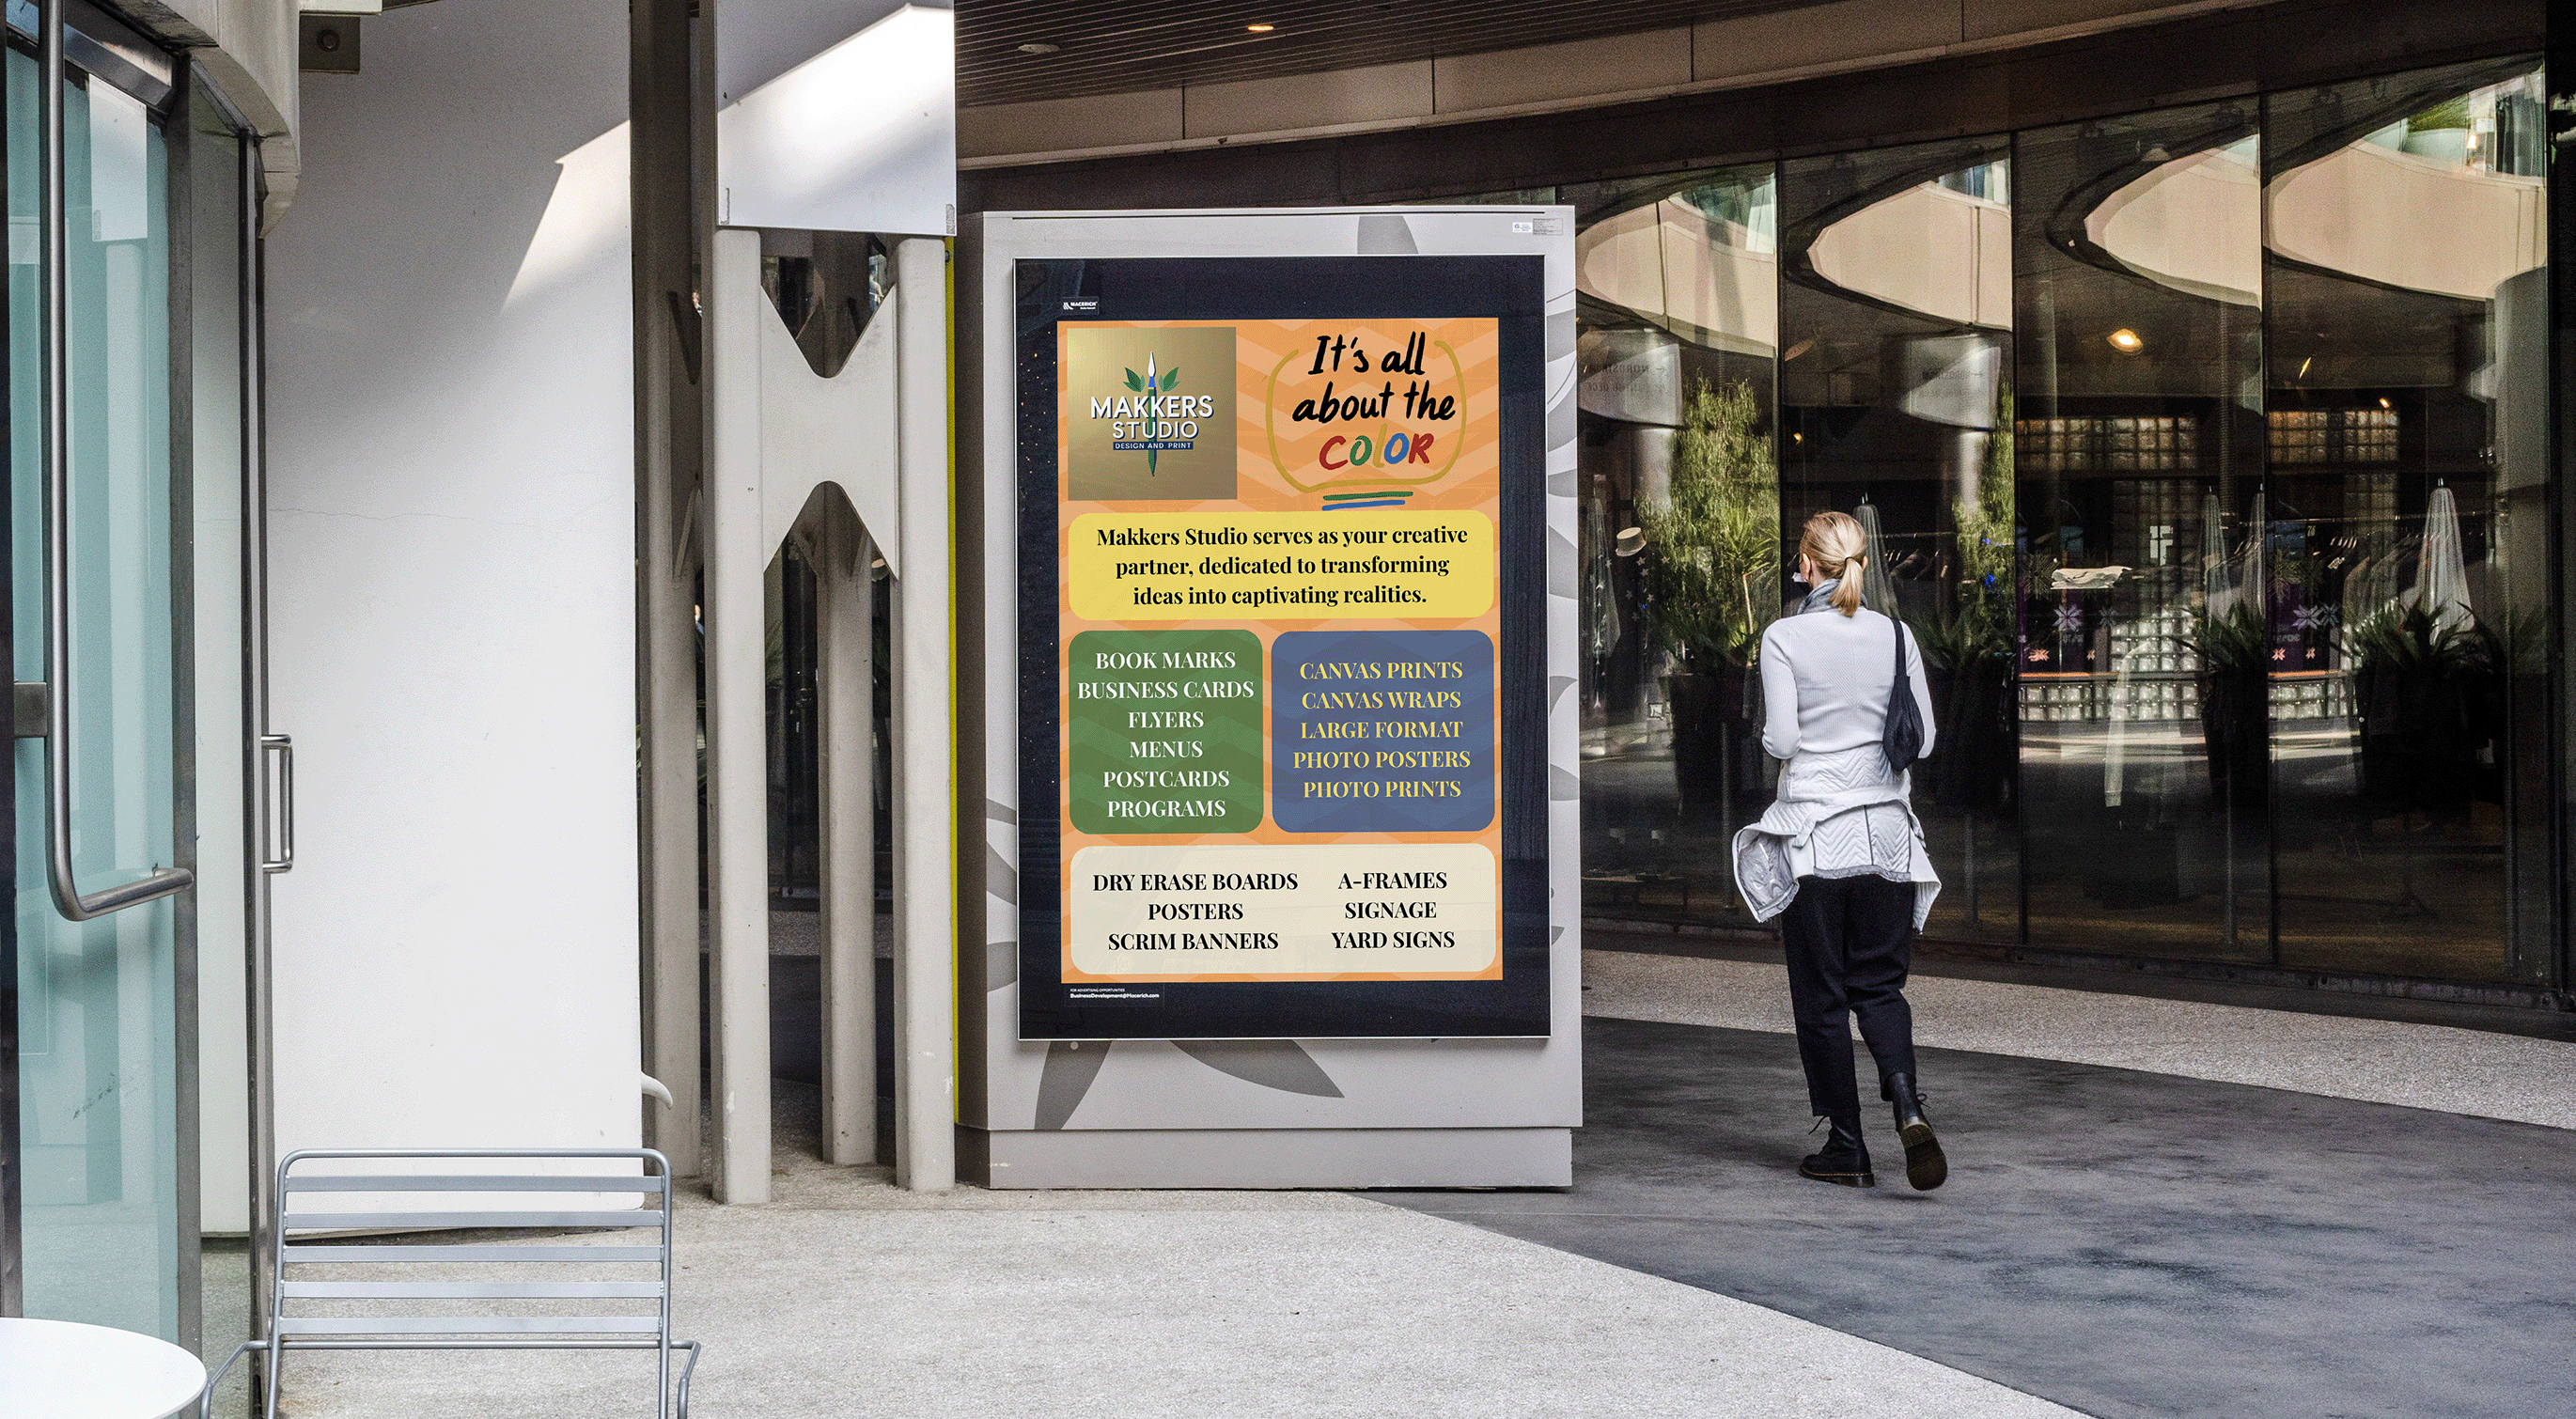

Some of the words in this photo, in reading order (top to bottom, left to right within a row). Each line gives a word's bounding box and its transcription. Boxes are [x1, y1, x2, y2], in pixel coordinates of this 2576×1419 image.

[1307, 334, 1369, 375] It's
[1381, 331, 1426, 376] all
[1090, 395, 1214, 419] MAKKERS
[1291, 381, 1395, 424] about
[1403, 380, 1456, 421] the
[1113, 420, 1199, 440] STUDIO
[1115, 442, 1145, 450] DESIGN
[1097, 527, 1180, 546] Makkers
[1185, 526, 1248, 546] Studio
[1253, 531, 1313, 545] serves
[1318, 531, 1338, 545] as
[1342, 531, 1388, 548] your
[1392, 525, 1468, 544] creative
[1116, 559, 1194, 580] partner,
[1198, 555, 1292, 575] dedicated
[1297, 558, 1316, 574] to
[1320, 554, 1450, 577] transforming
[1133, 586, 1183, 605] ideas
[1188, 586, 1226, 605] into
[1231, 585, 1339, 608] captivating
[1343, 585, 1427, 603] realities.
[1095, 651, 1158, 670] BOOK
[1162, 651, 1236, 669] MARKS
[1300, 662, 1382, 680] CANVAS
[1386, 661, 1463, 679] PRINTS
[1077, 681, 1179, 699] BUSINESS
[1183, 680, 1255, 699] CARDS
[1302, 692, 1383, 710] CANVAS
[1386, 691, 1461, 709] WRAPS
[1128, 710, 1205, 728] FLYERS
[1301, 722, 1369, 739] LARGE
[1375, 721, 1464, 739] FORMAT
[1129, 740, 1203, 758] MENUS
[1293, 751, 1370, 769] PHOTO
[1375, 750, 1471, 769] POSTERS
[1103, 770, 1230, 788] POSTCARDS
[1304, 780, 1380, 799] PHOTO
[1384, 780, 1461, 798] PRINTS
[1107, 799, 1226, 819] PROGRAMS
[1093, 874, 1136, 892] DRY
[1140, 873, 1207, 891] ERASE
[1212, 872, 1299, 891] BOARDS
[1337, 871, 1447, 890] A-FRAMES
[1148, 903, 1243, 921] POSTERS
[1345, 901, 1437, 919] SIGNAGE
[1108, 933, 1177, 951] SCRIM
[1181, 932, 1279, 950] BANNERS
[1331, 931, 1388, 949] YARD
[1393, 930, 1456, 949] SIGNS
